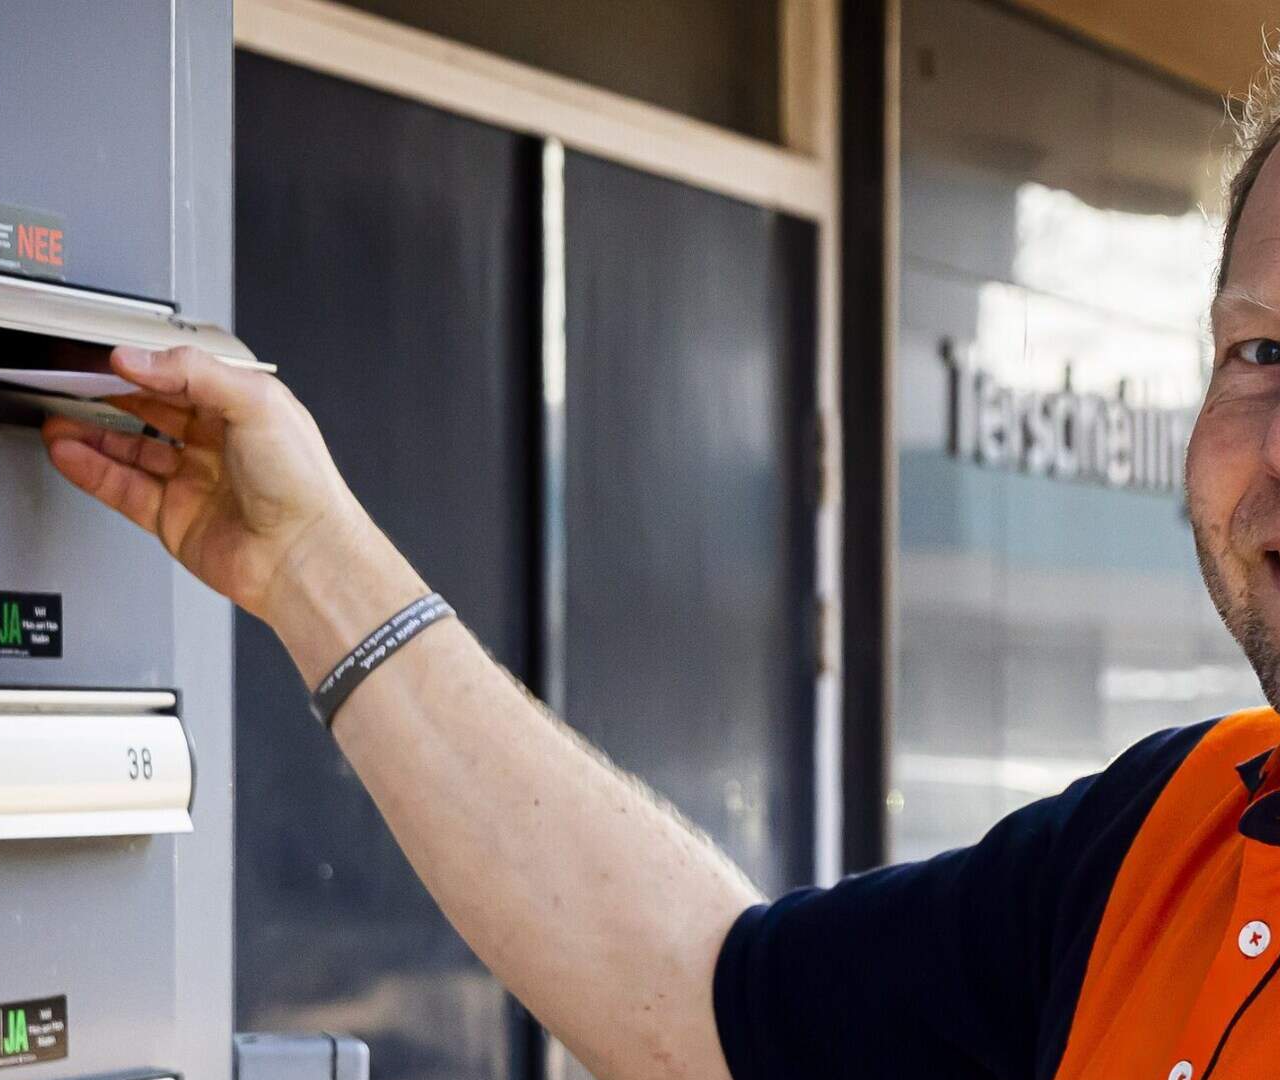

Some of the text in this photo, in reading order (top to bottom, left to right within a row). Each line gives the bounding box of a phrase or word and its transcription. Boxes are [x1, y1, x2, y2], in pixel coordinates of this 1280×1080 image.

[17, 223, 64, 267] NEE
[0, 602, 22, 645] JA
[127, 748, 153, 780] 38
[4, 1008, 29, 1055] JA
